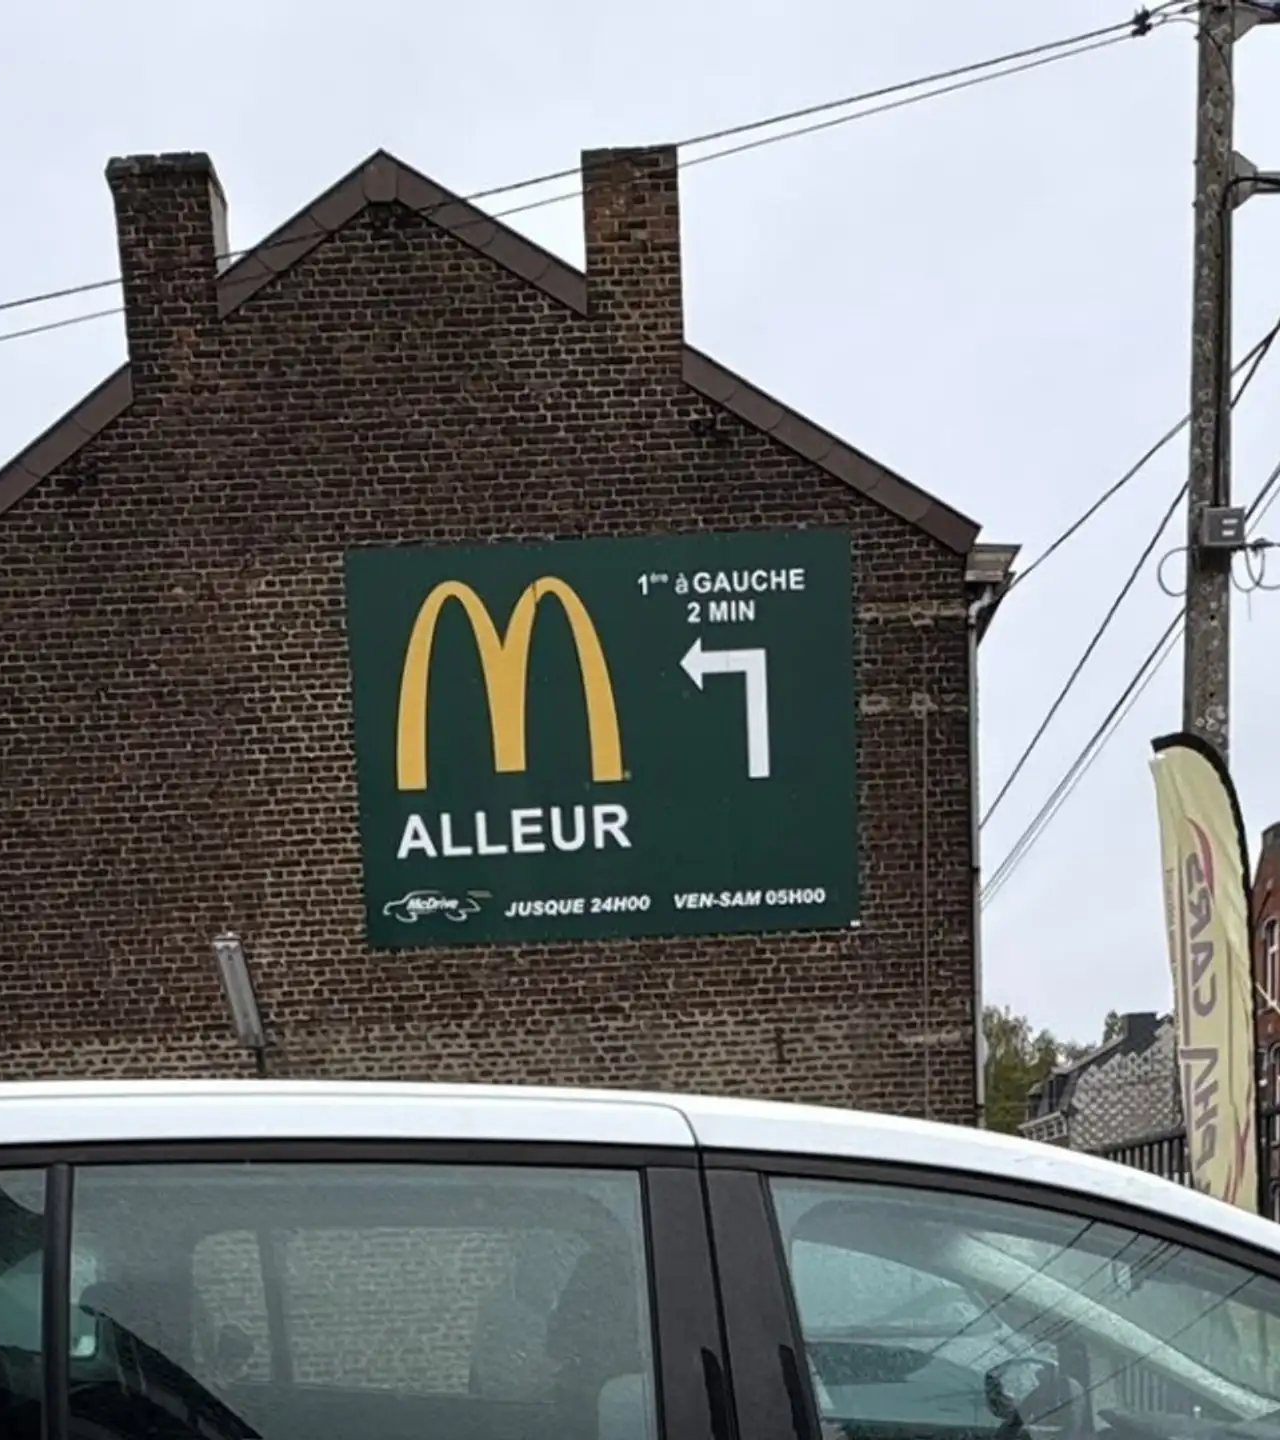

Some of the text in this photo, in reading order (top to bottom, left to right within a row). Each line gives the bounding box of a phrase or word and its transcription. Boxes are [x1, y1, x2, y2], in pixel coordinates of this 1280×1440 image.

[675, 571, 689, 595] à
[692, 568, 806, 594] GAUCHE
[686, 600, 756, 624] 2 MIN
[396, 803, 633, 860] ALLEUR
[406, 895, 459, 910] McDrive
[504, 887, 827, 918] JUSQUE 24H00 VEN-SAM 05H00
